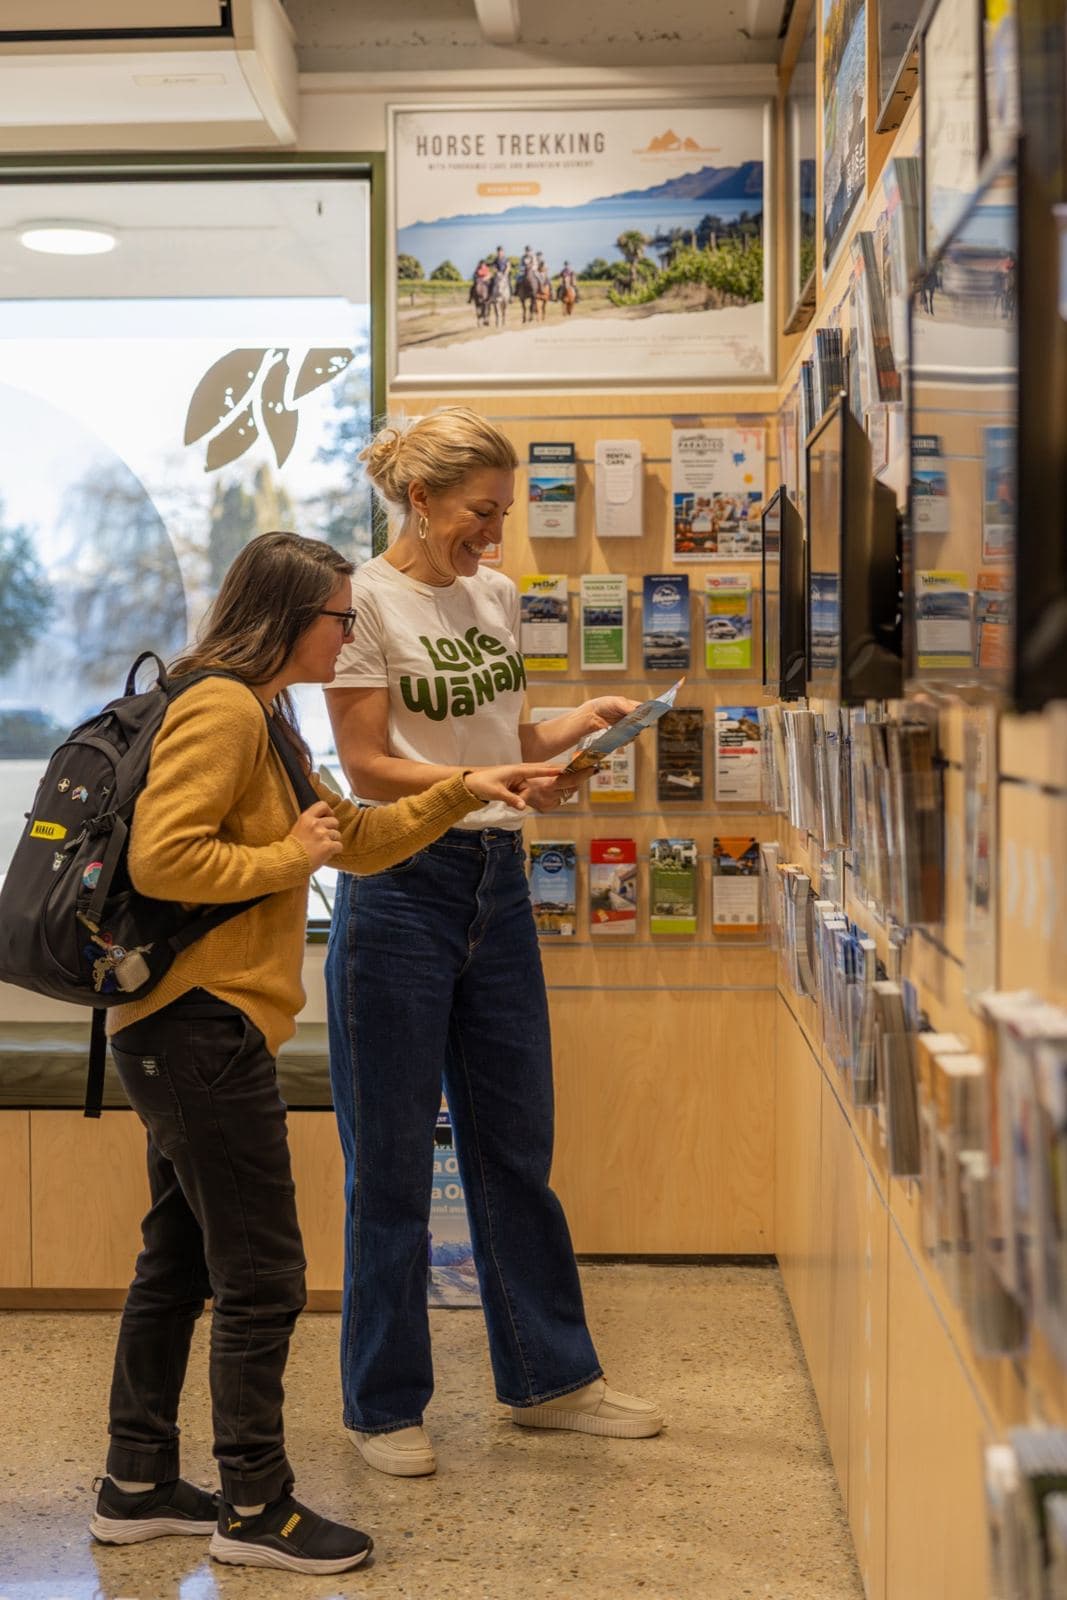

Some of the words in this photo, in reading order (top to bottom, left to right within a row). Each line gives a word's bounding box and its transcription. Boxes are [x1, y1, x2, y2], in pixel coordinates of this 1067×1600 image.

[416, 135, 486, 157] HORSE
[497, 132, 606, 156] TREKKING
[418, 626, 507, 672] Love
[281, 1513, 301, 1538] PUMA
